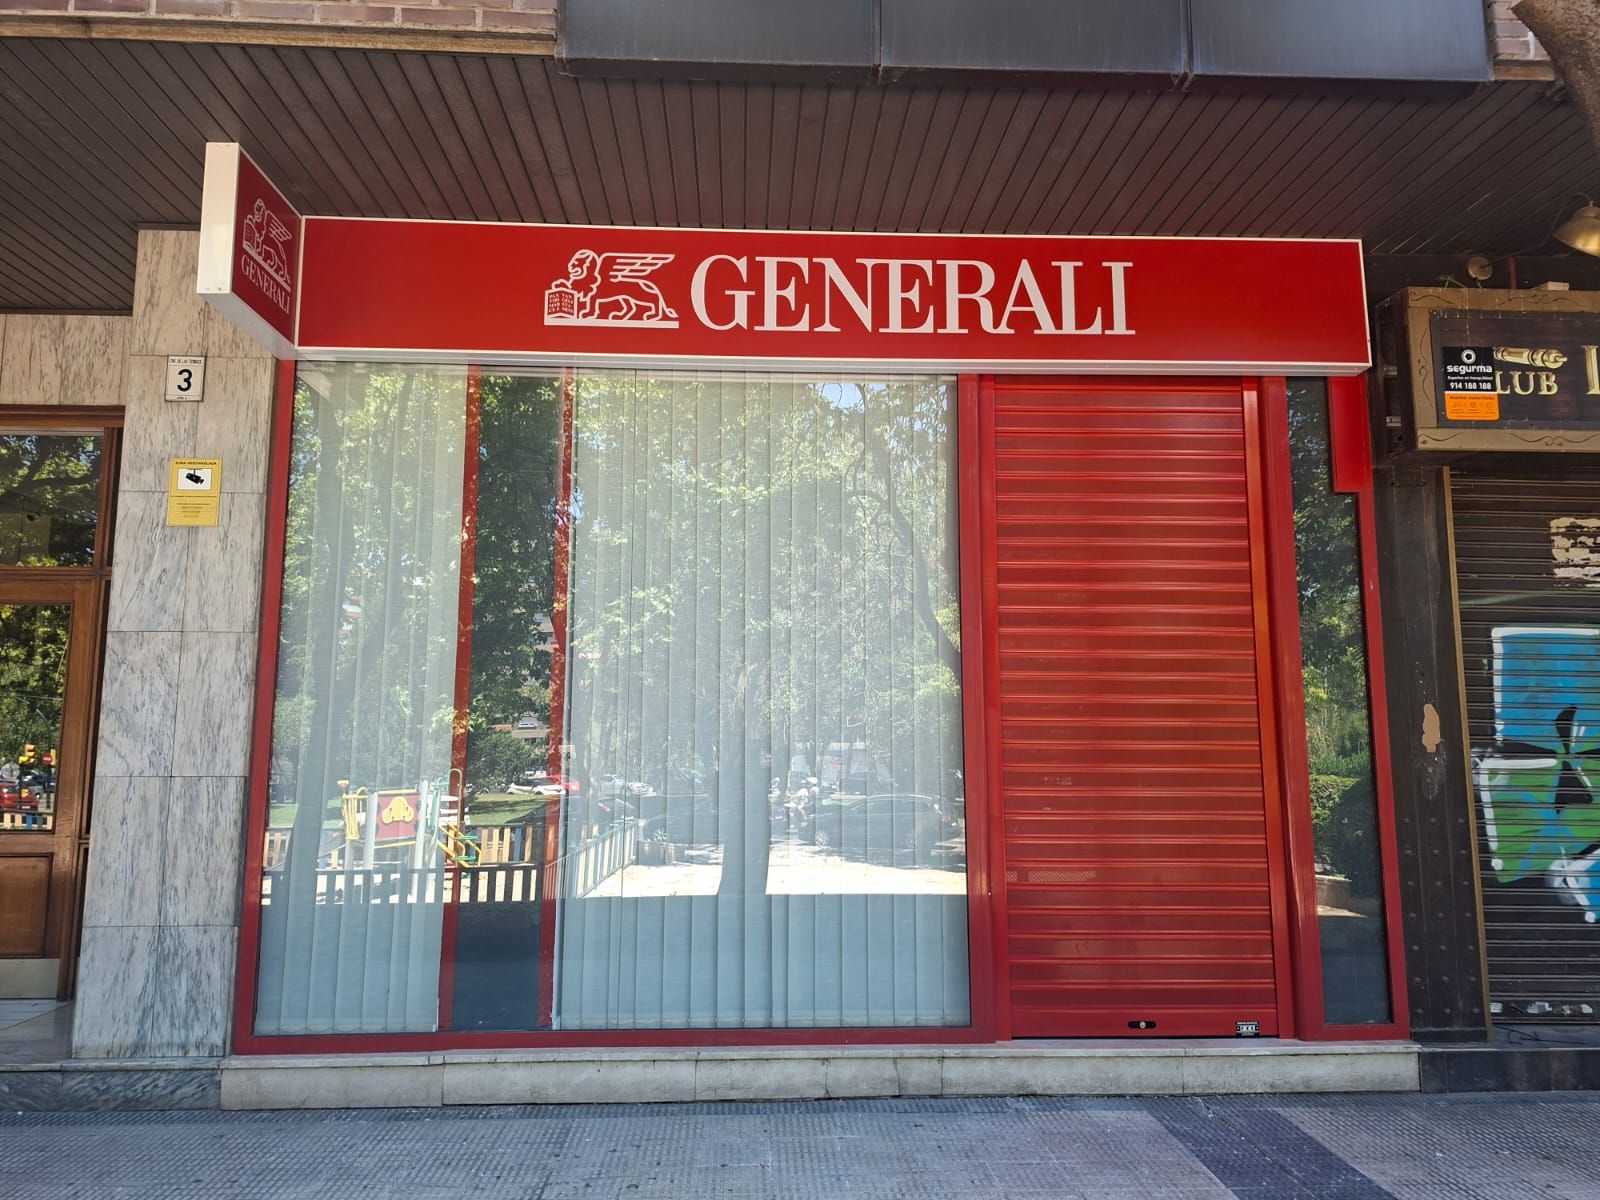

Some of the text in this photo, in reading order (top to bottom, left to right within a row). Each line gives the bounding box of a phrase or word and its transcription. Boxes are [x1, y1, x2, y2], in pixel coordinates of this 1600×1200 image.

[240, 254, 291, 315] GENERALI
[690, 254, 1136, 335] GENERALI
[176, 368, 193, 392] 3
[1446, 364, 1493, 375] segurma
[1450, 382, 1463, 390] 914
[1496, 372, 1558, 395] LUB
